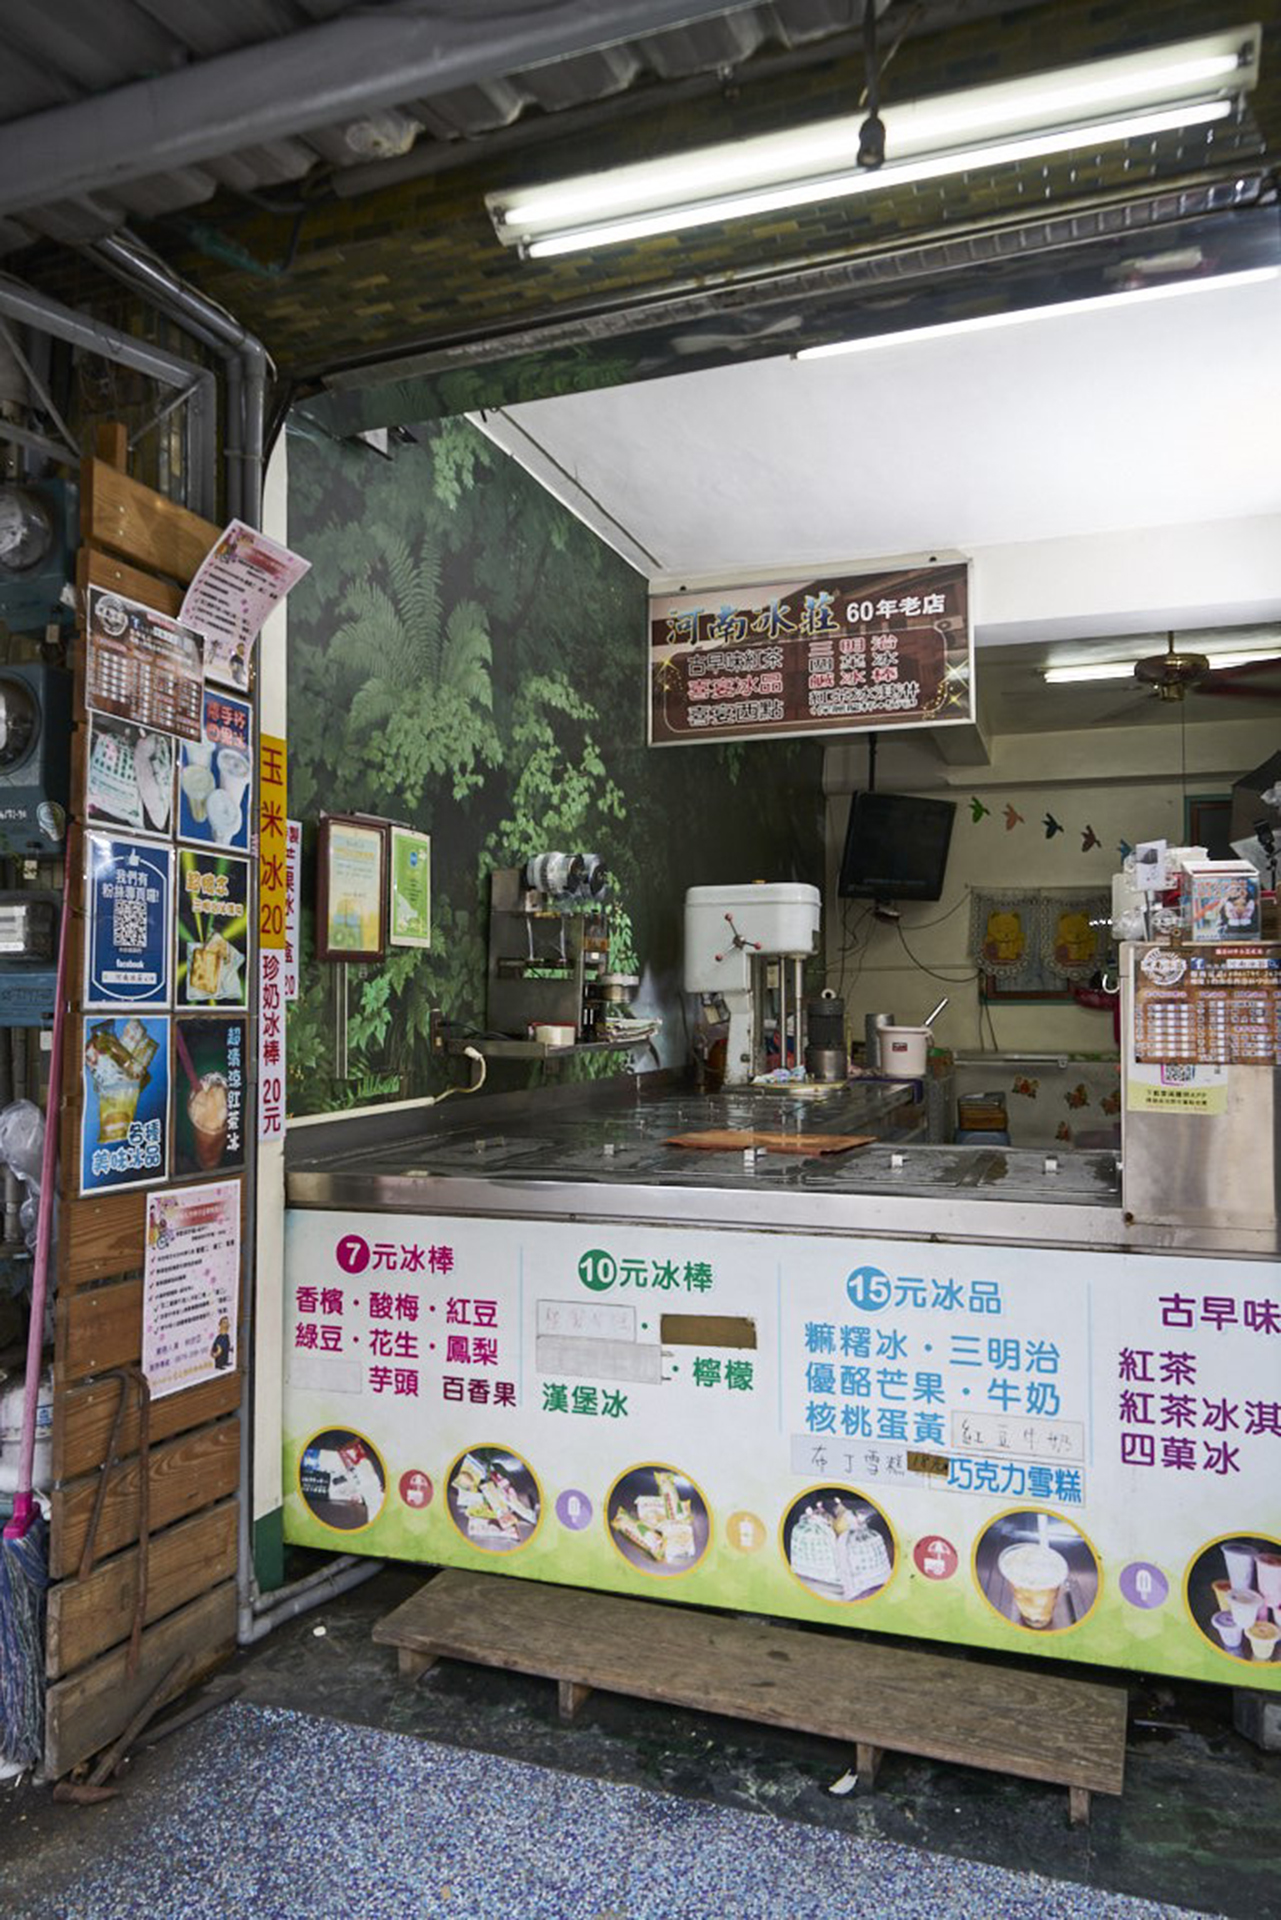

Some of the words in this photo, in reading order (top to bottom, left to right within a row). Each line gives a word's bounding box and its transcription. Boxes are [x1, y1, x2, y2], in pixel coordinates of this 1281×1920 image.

[667, 591, 839, 645] 河南冰莊
[846, 593, 945, 623] 60年老店
[687, 646, 784, 676] 古早味紅茶
[261, 746, 284, 891] 玉米冰
[261, 904, 283, 934] 20
[262, 955, 281, 1066] 珍奶冰棒
[92, 1143, 161, 1176] 美味冰品
[1159, 1293, 1281, 1334] 古早味
[692, 1357, 754, 1391] 檸檬
[1118, 1347, 1197, 1386] 紅茶
[442, 1376, 517, 1408] 百香果
[542, 1382, 629, 1418] 漢堡冰
[805, 1401, 946, 1446] 核桃蛋黃
[1119, 1389, 1281, 1437] 紅茶冰淇
[1121, 1432, 1241, 1475] 四菓冰
[947, 1457, 1083, 1503] 巧克力雪糕
